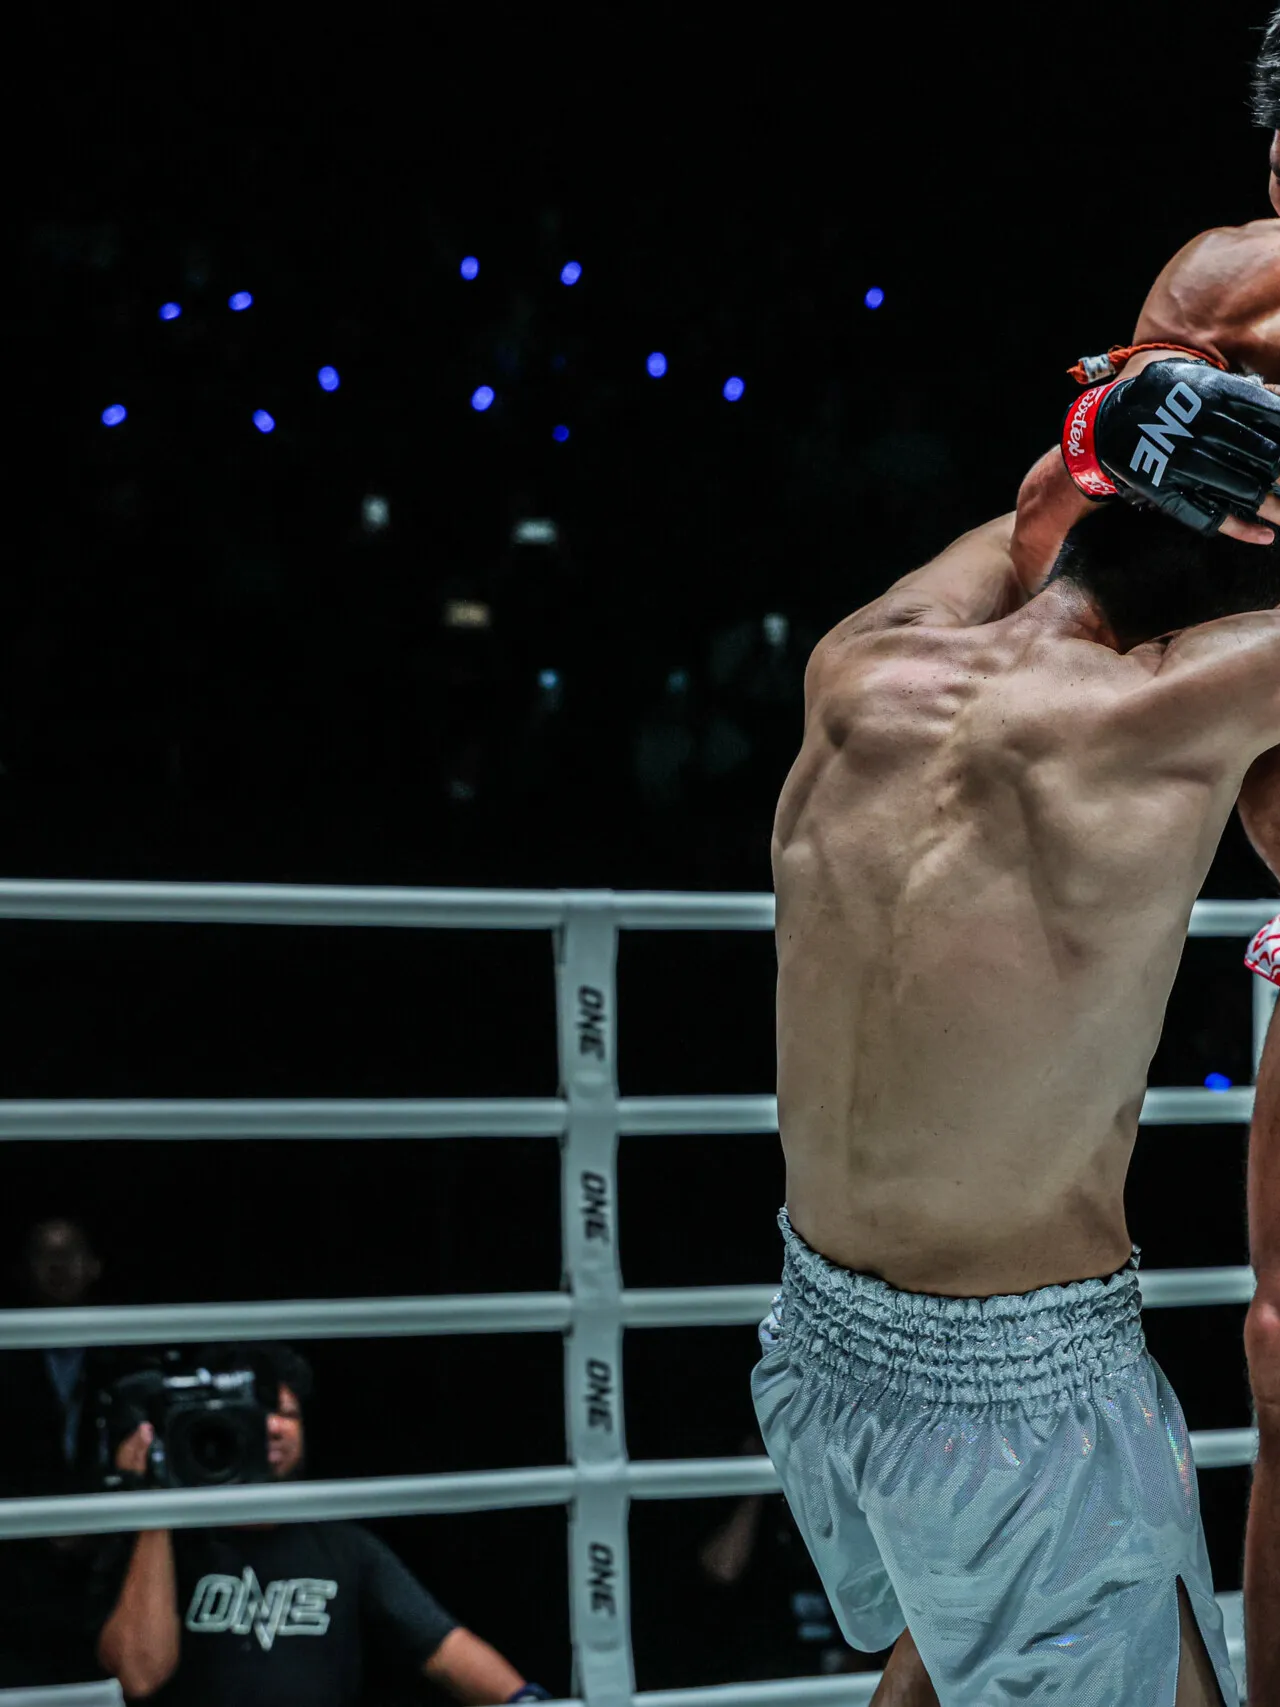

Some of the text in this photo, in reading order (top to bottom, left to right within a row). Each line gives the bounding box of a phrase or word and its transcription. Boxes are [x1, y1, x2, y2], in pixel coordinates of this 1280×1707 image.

[1129, 381, 1202, 488] ONE
[576, 985, 606, 1062] ONE
[580, 1171, 610, 1246] ONE
[585, 1358, 613, 1434] ONE
[186, 1566, 338, 1651] ONE
[587, 1541, 617, 1618] ONE
